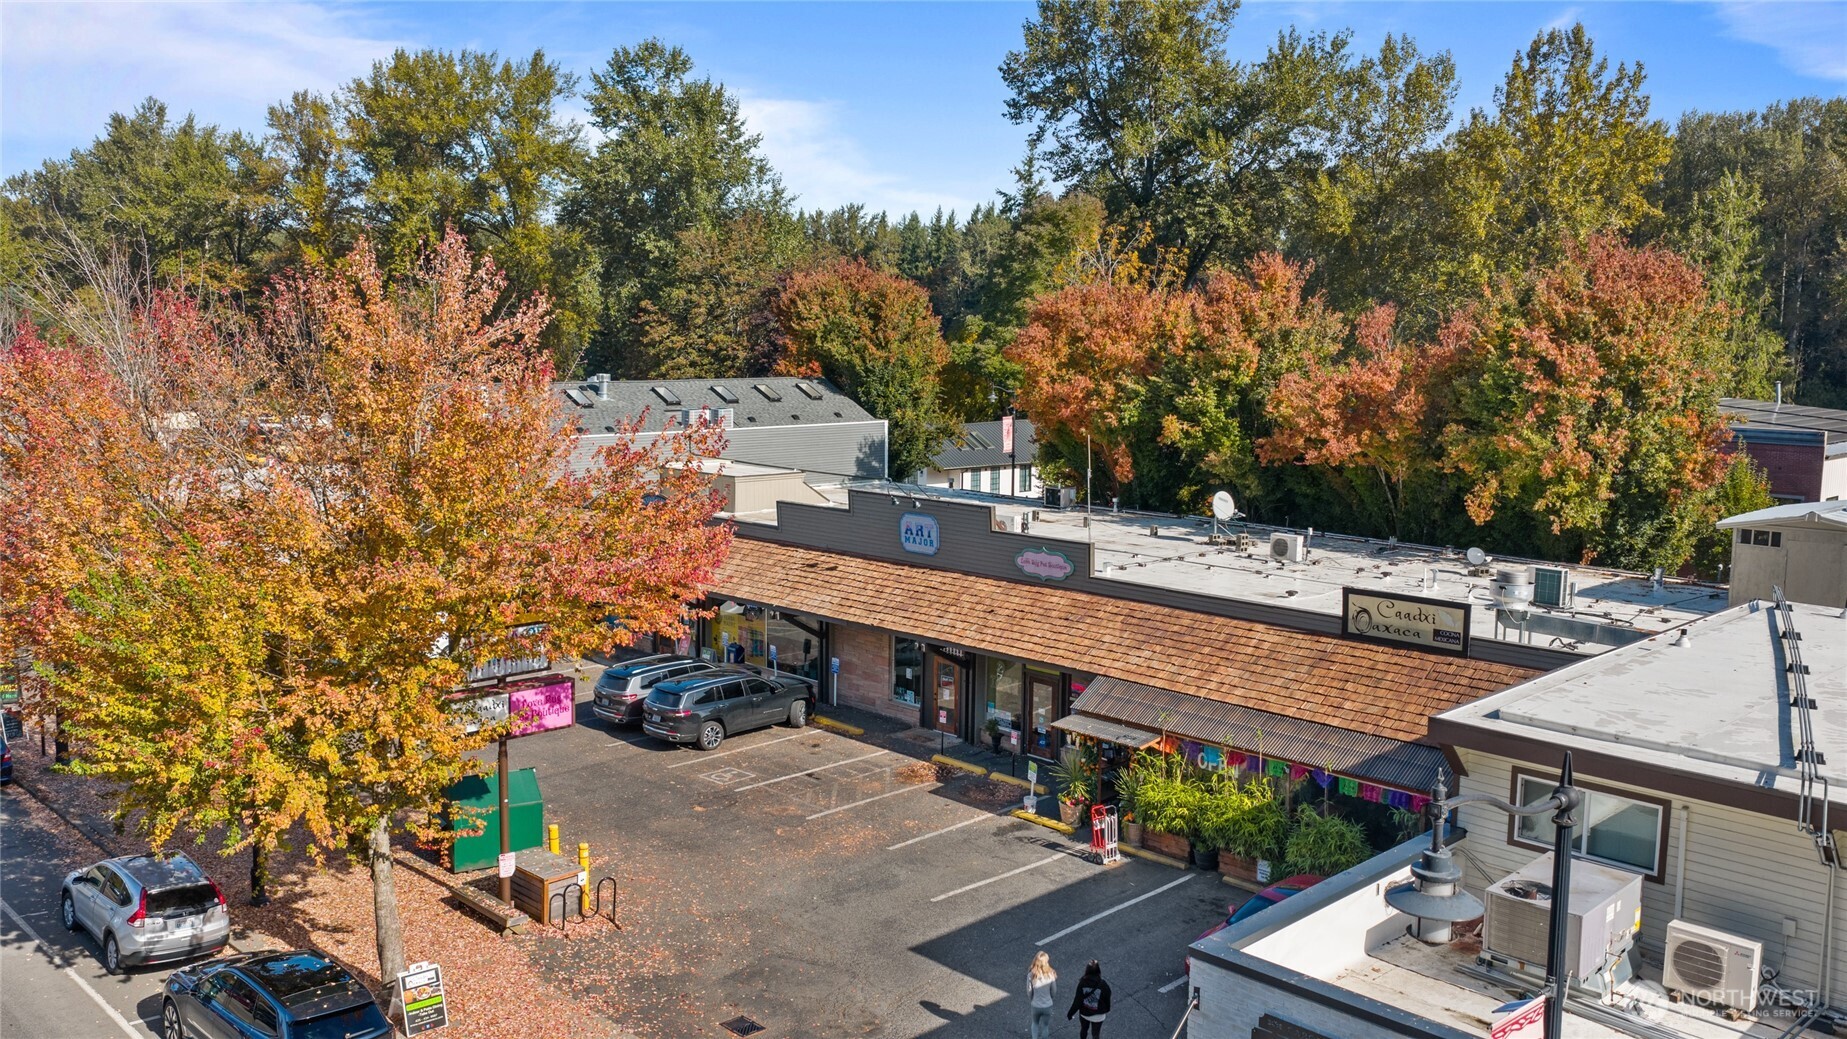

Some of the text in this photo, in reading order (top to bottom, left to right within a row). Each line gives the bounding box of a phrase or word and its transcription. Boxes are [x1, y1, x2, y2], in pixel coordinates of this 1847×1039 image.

[904, 520, 934, 538] ART
[904, 535, 934, 547] MAJOR
[1352, 602, 1421, 638] Oaxaca
[1377, 600, 1436, 625] Caadxi
